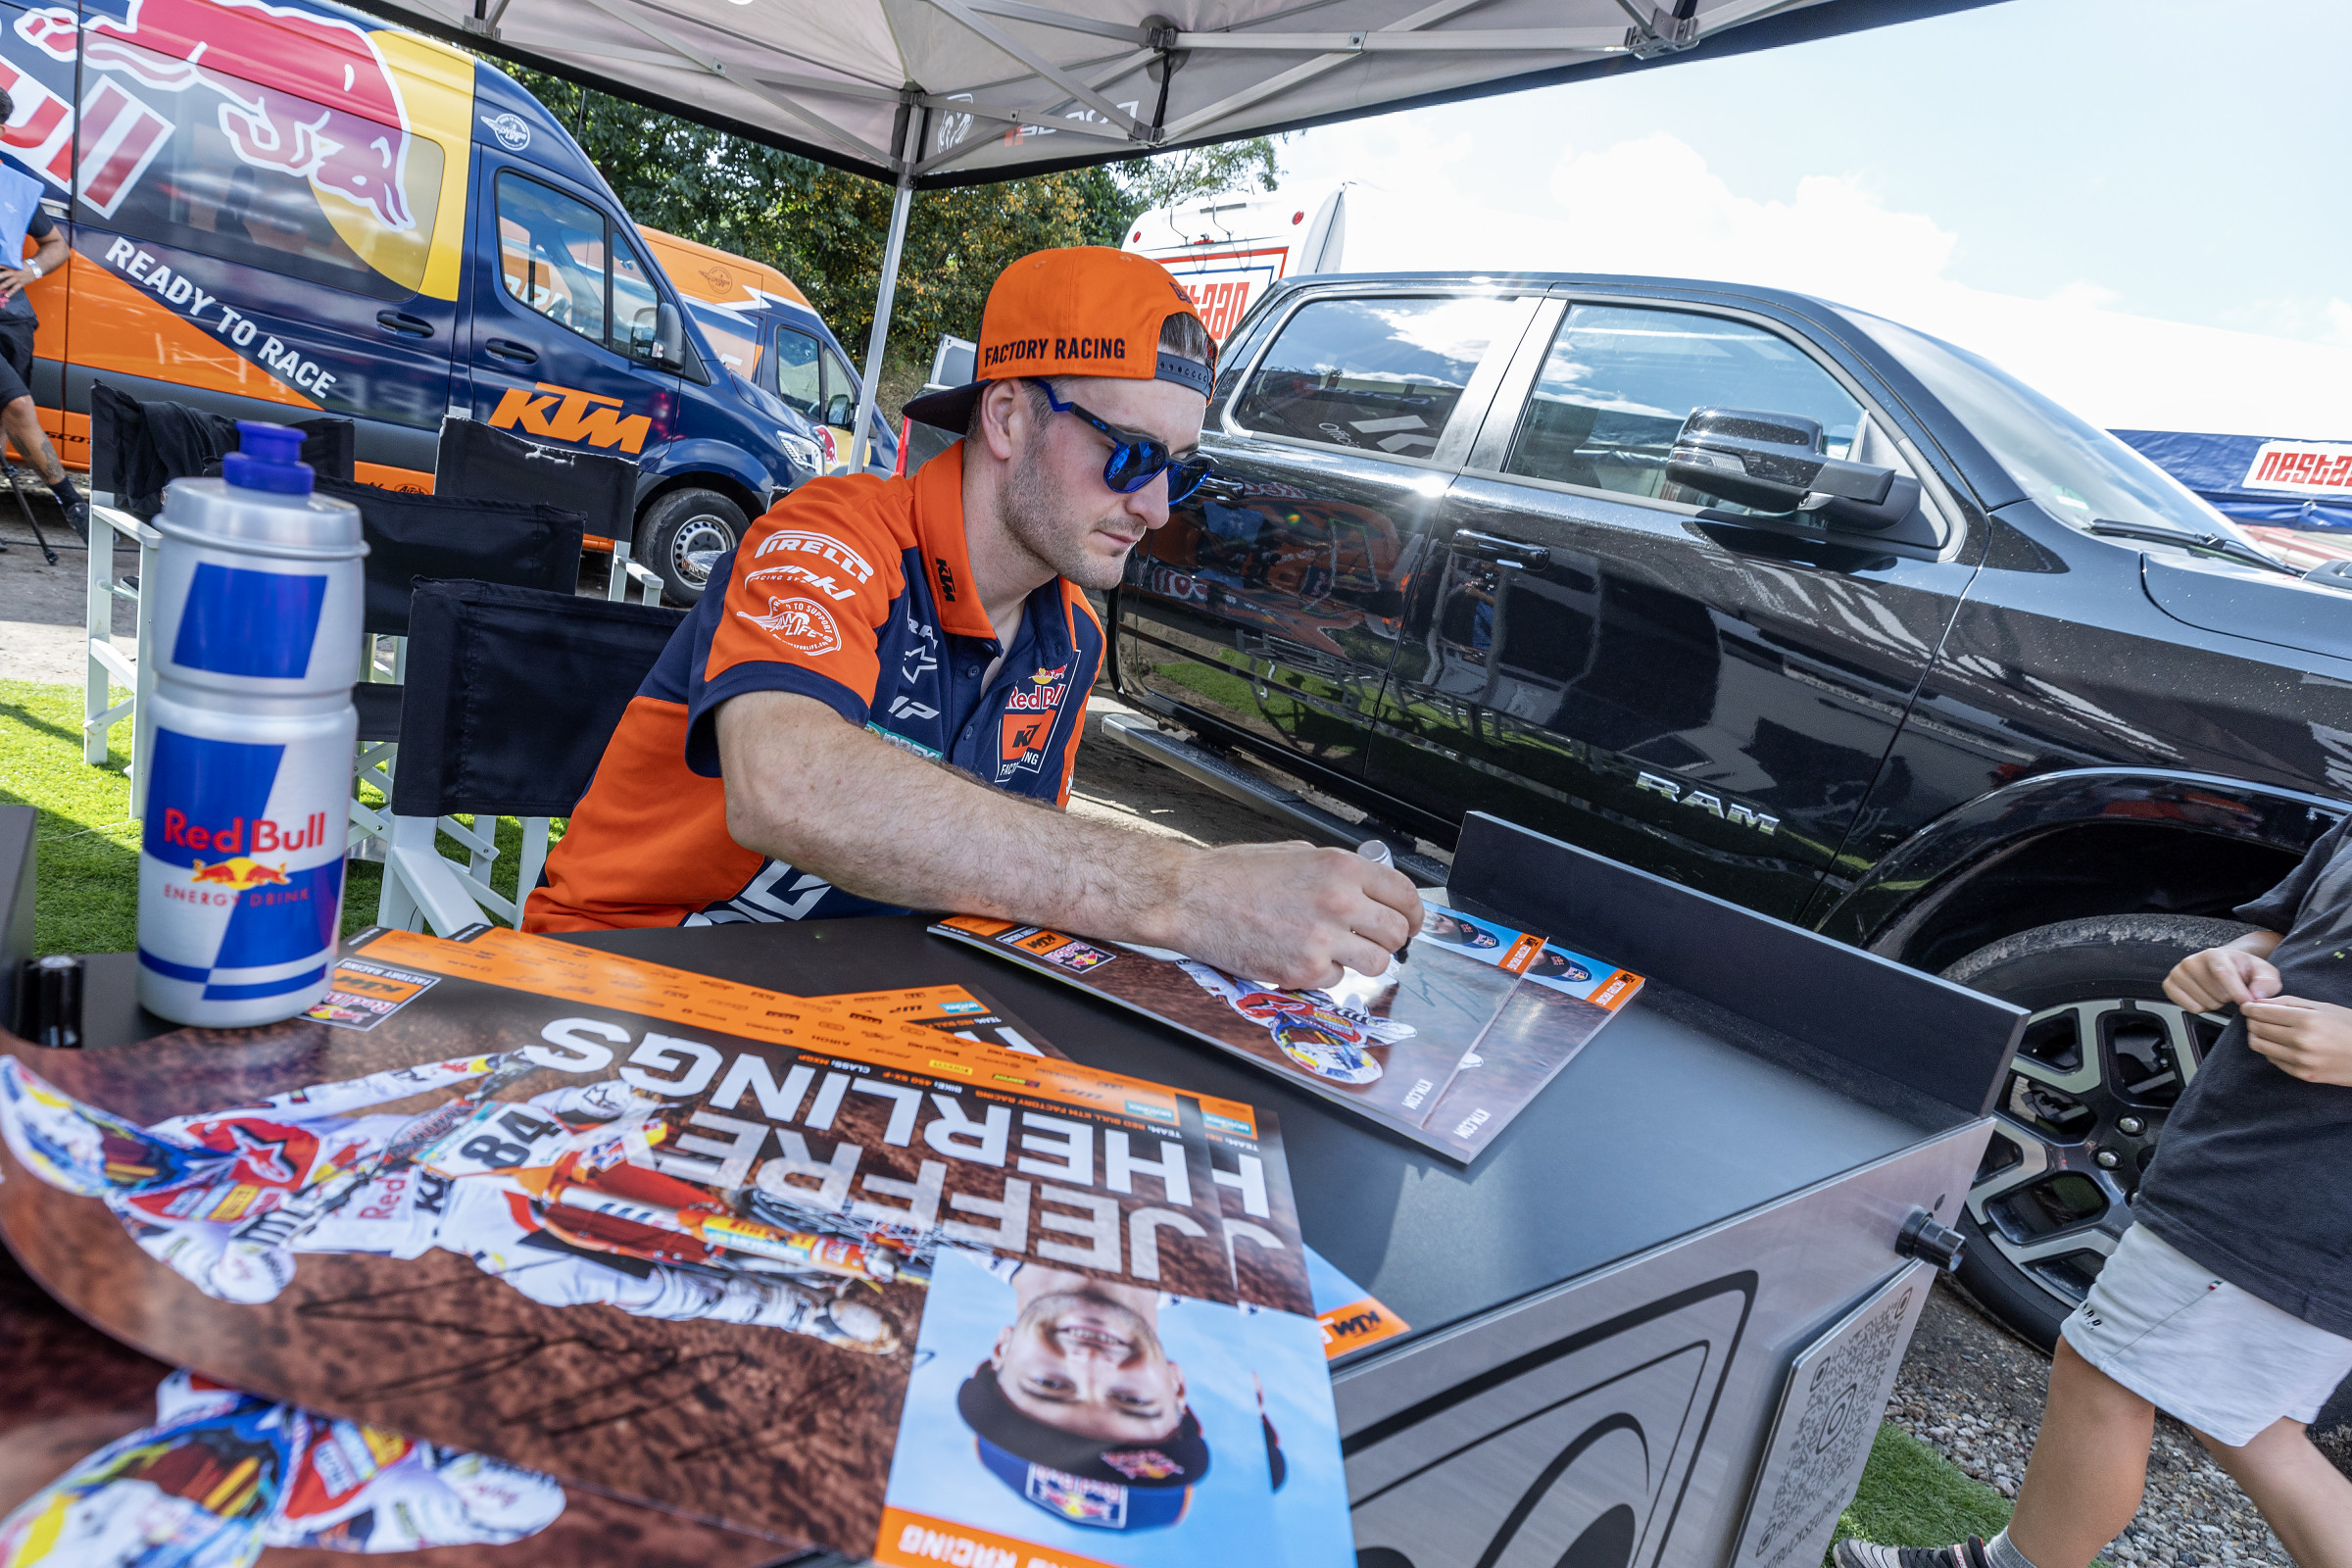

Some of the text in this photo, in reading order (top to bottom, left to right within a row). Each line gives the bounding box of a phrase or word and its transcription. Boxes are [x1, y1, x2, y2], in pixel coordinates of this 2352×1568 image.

[105, 236, 336, 399] READY TO RACE
[985, 338, 1126, 368] FACTORY RACING
[487, 381, 653, 455] KTM
[45, 431, 90, 445] SCO
[755, 530, 874, 585] PIRELLI
[936, 557, 956, 603] KTM
[806, 605, 833, 634] SUPPORT
[1005, 684, 1066, 710] Red Bll
[1012, 722, 1042, 749] KT
[1021, 751, 1040, 765] ING
[1635, 771, 1781, 837] RAM
[164, 807, 325, 854] Red Bull
[164, 883, 311, 907] ENERGY DRINK
[1026, 934, 1056, 950] KTM
[340, 961, 432, 986] FACTORY RACING
[348, 995, 398, 1015] Red
[831, 1058, 871, 1075] CLASS:
[933, 1081, 962, 1095] BIKE:
[975, 1090, 1016, 1104] RACING
[1401, 1078, 1434, 1110] KTM.COM
[523, 1017, 1193, 1206] HERLINGS
[1017, 1098, 1068, 1113] FACTORY
[1148, 1124, 1182, 1139] TEAM:
[1453, 1107, 1492, 1140] KTM.COM
[460, 1110, 564, 1169] 84
[1225, 1136, 1260, 1152] TEAM:
[1333, 1311, 1382, 1339] KTM
